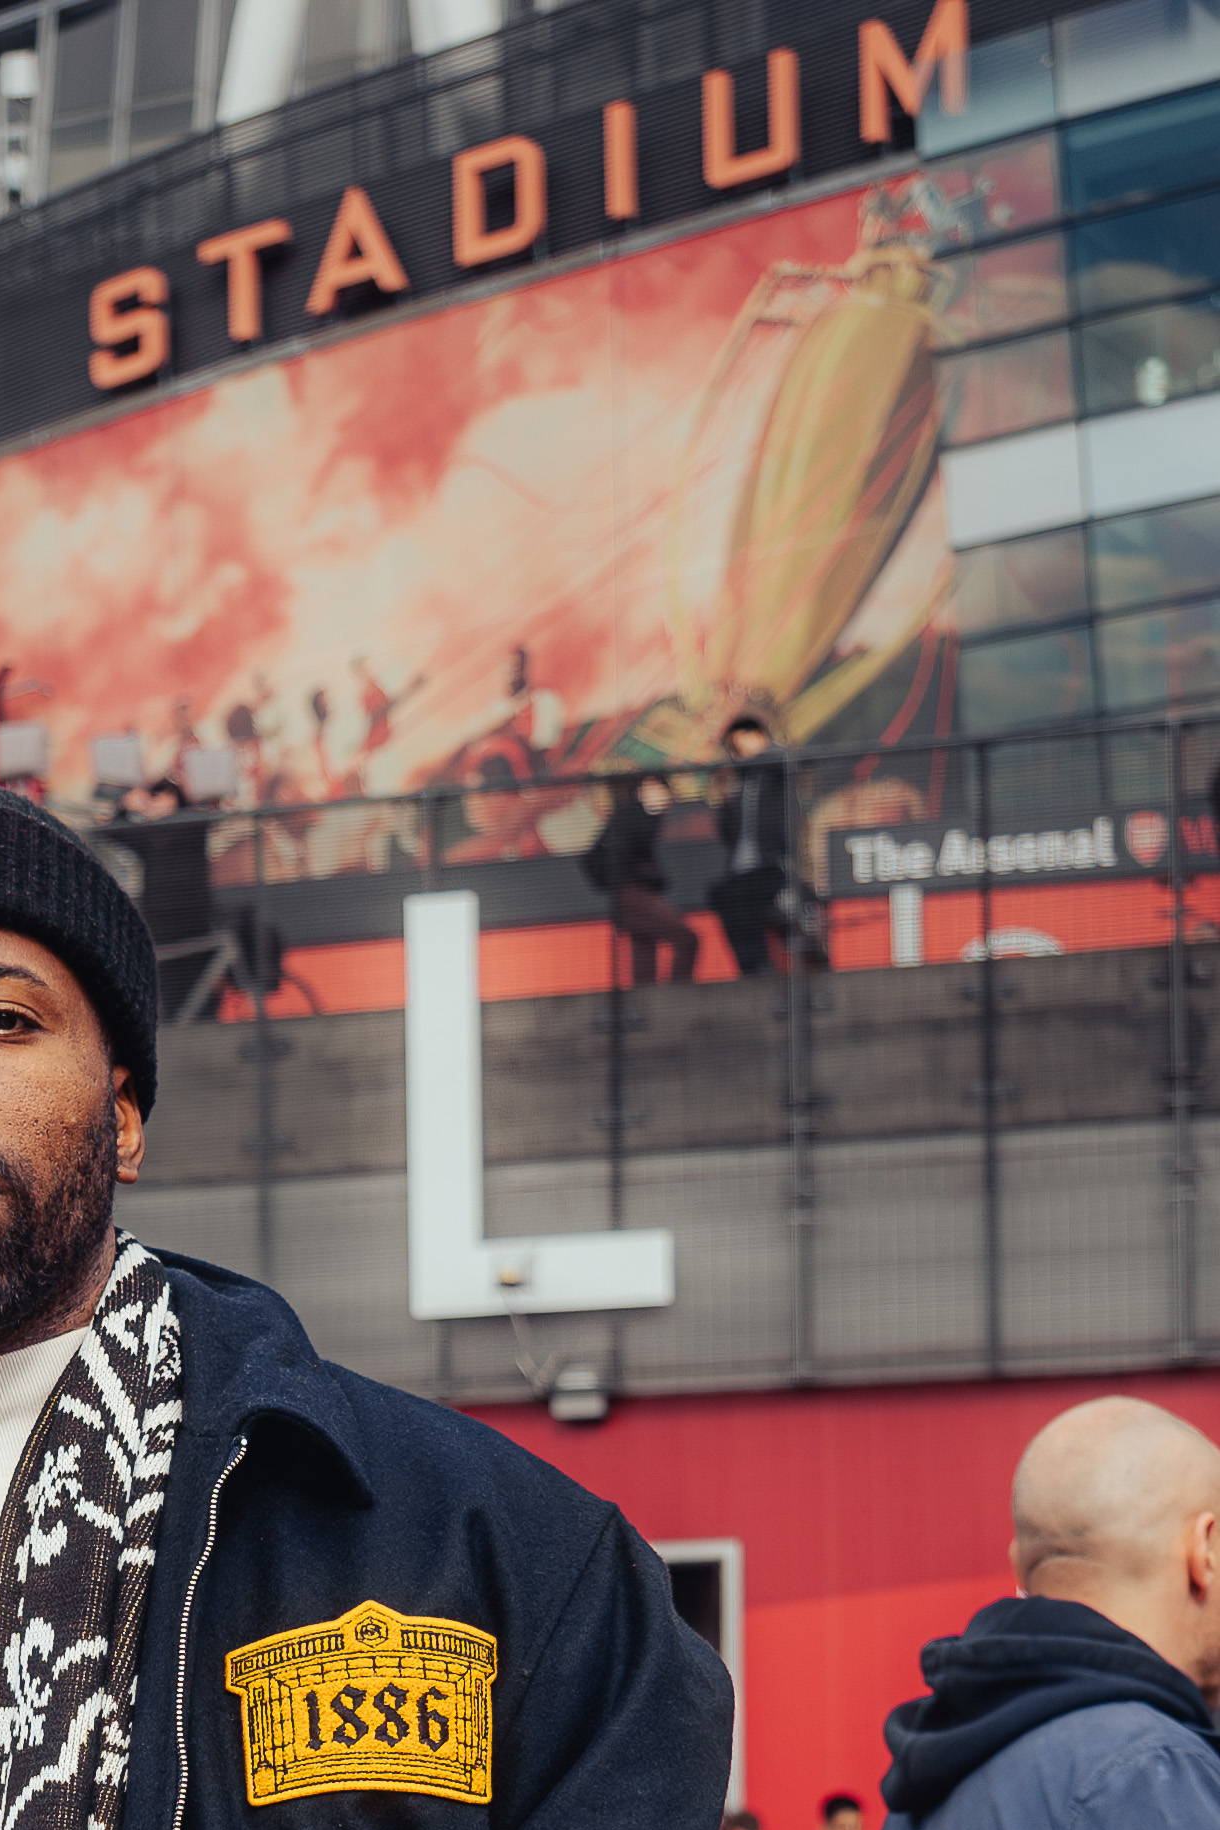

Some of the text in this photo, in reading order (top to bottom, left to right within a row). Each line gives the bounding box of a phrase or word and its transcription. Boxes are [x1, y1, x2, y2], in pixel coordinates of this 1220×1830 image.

[86, 0, 970, 391] STADIUM
[844, 830, 935, 884] The
[936, 814, 1119, 878] Arsenal
[303, 1681, 451, 1753] 1886
